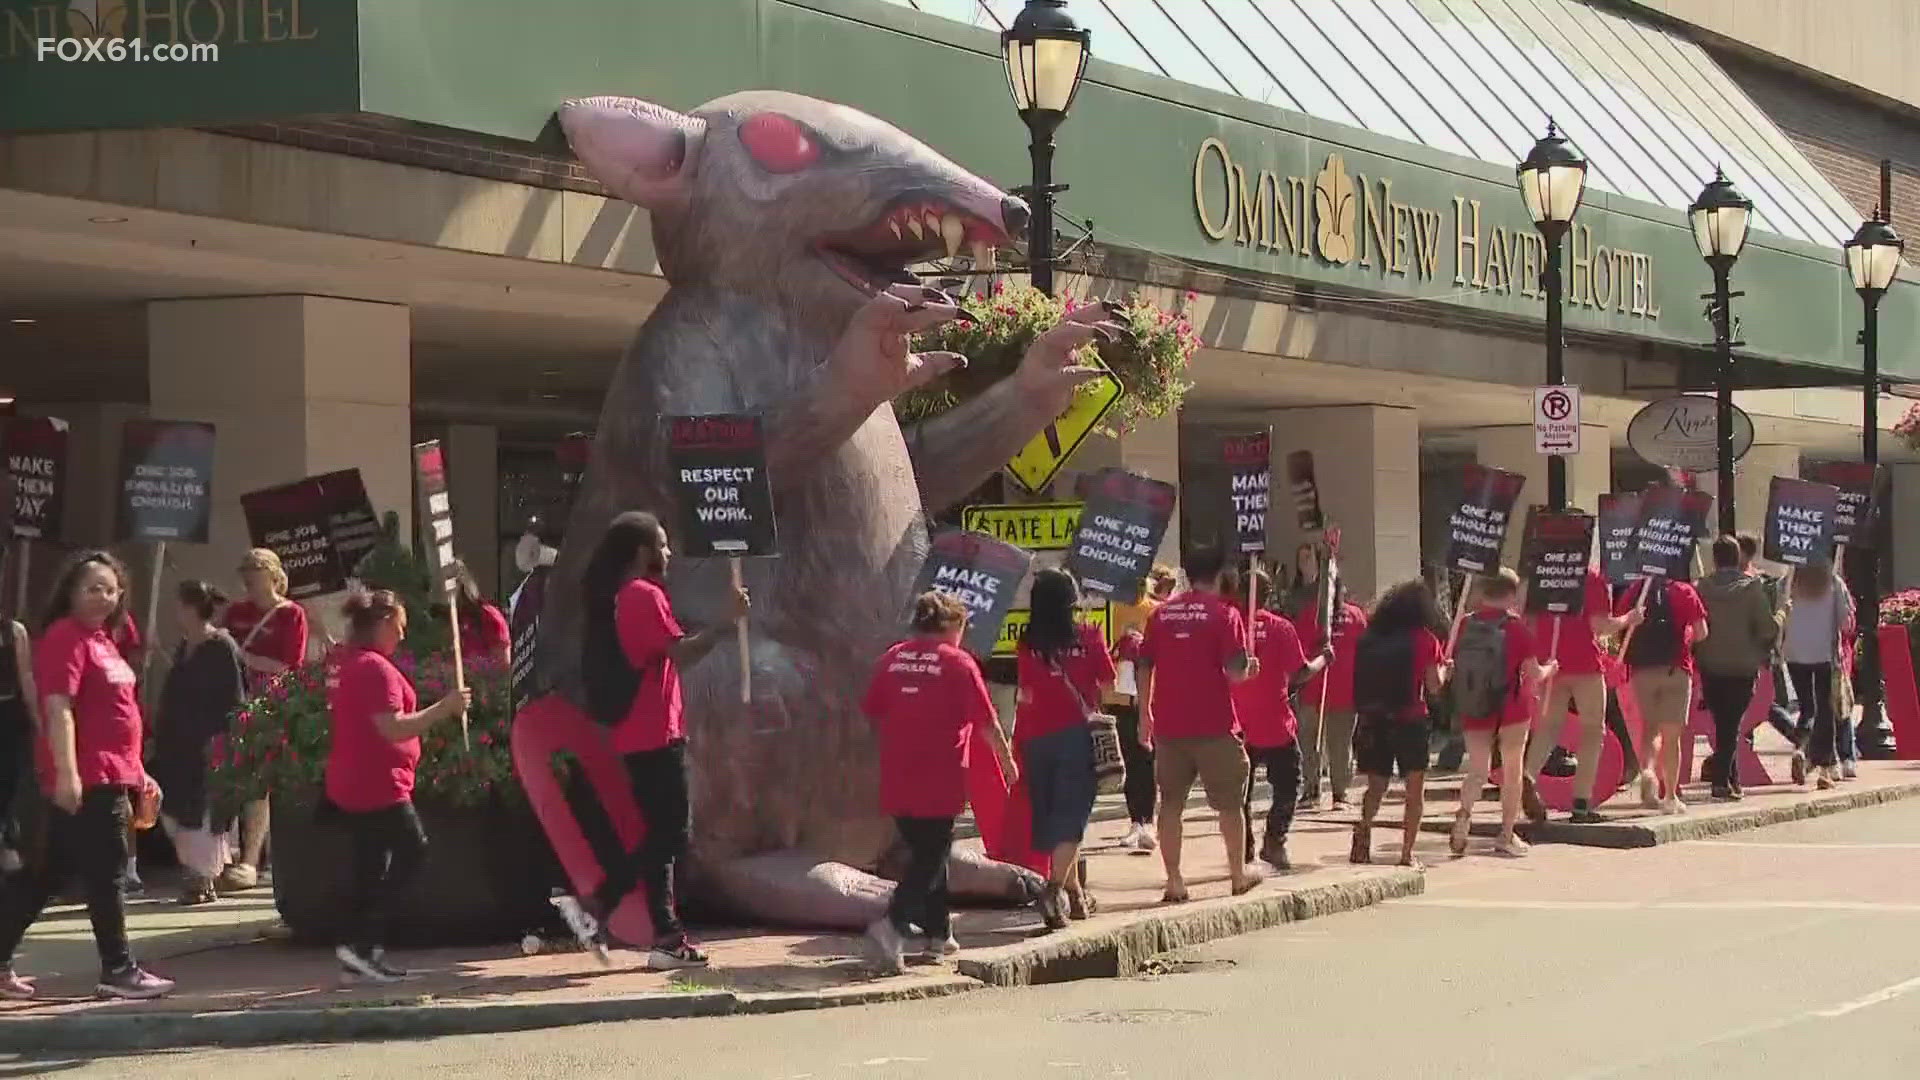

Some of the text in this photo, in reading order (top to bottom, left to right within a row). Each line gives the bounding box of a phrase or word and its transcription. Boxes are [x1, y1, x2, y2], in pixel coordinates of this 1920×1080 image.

[1194, 136, 1312, 257] OMNI
[1358, 172, 1443, 281] NEW
[1569, 221, 1661, 321] HOTEL
[1536, 423, 1577, 433] No Parking
[680, 467, 755, 483] RESPECT
[704, 486, 740, 503] OUR
[696, 507, 753, 522] WORK.
[1777, 505, 1824, 523] MAKE
[1094, 515, 1150, 539] ONE JOB
[1777, 519, 1823, 537] THEM
[1078, 527, 1153, 557] SHOULD BE
[1778, 534, 1814, 551] PAY.
[935, 564, 1001, 594] MAKE
